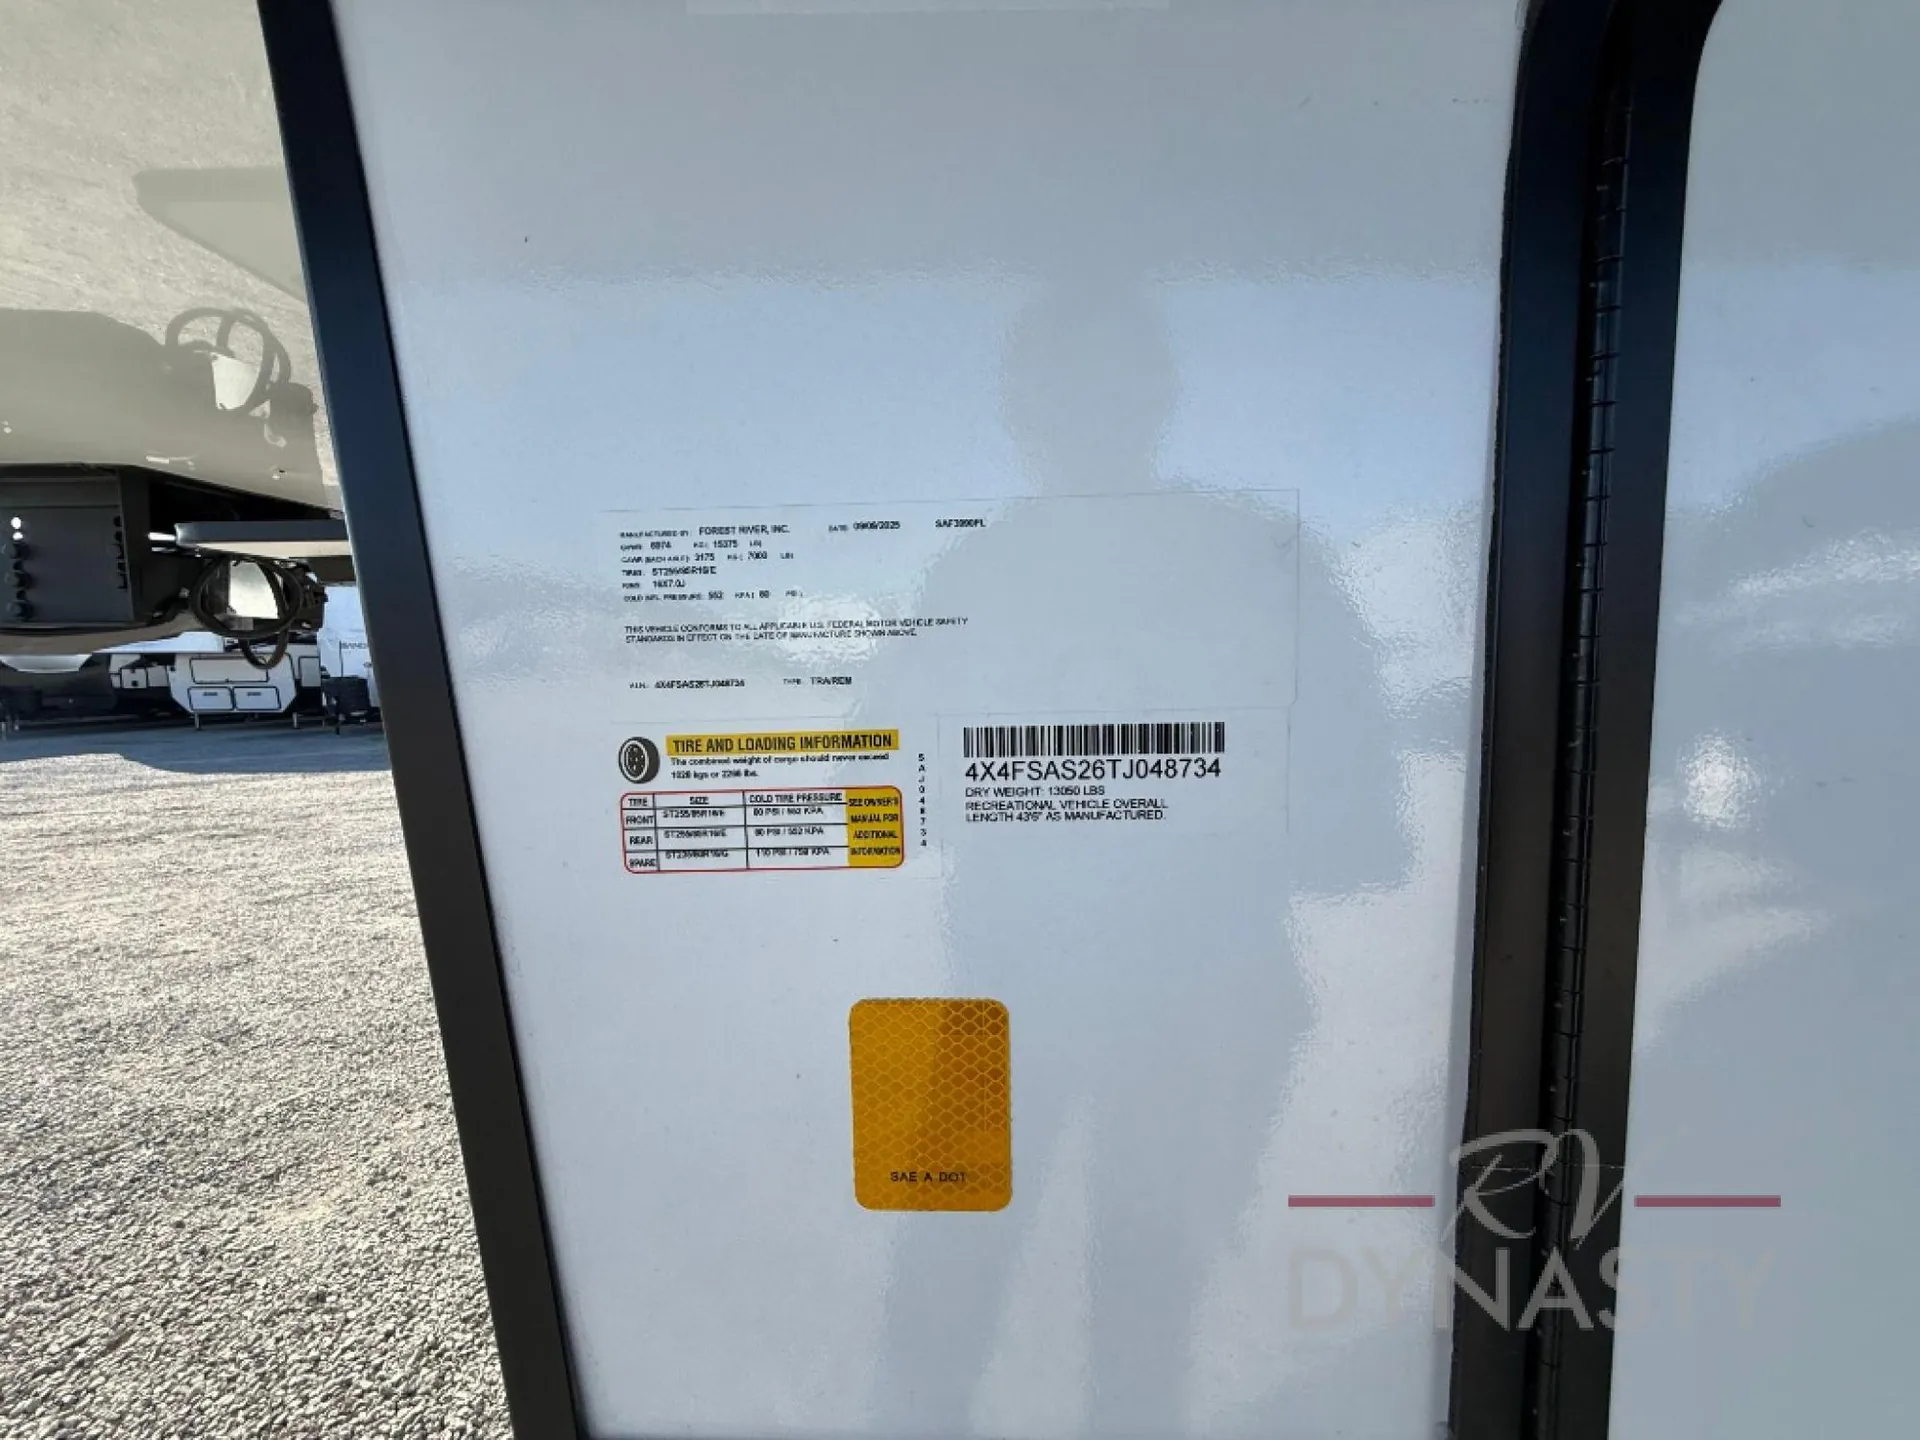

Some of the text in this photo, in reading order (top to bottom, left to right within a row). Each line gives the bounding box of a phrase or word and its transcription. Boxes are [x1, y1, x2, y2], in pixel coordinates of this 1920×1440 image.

[699, 526, 736, 536] FOREST
[827, 620, 864, 629] FEDERAL
[687, 633, 718, 642] EFFECT
[672, 733, 892, 753] TIRE AND LOADING INFORMATION
[671, 757, 687, 766] The
[688, 756, 731, 765] combined
[733, 755, 761, 766] weight
[763, 755, 773, 764] of
[800, 753, 829, 763] should
[832, 754, 856, 762] never
[965, 757, 1221, 782] 4X4FSAS26TJ048734
[965, 786, 992, 798] DRY
[1083, 784, 1105, 796] LBS
[627, 797, 648, 807] TIRE
[689, 795, 710, 805] SIZE
[750, 792, 843, 803] COLD TIRE PRESSURE
[848, 798, 862, 807] SEE
[965, 798, 1168, 811] RECREATIONAL VEHICLE OVERALL
[625, 815, 654, 825] FRONT
[850, 813, 881, 823] MANUAL
[965, 811, 1014, 823] LENGTH
[1045, 810, 1061, 822] AS
[629, 835, 653, 845] REAR
[629, 857, 656, 868] SPARE
[890, 1171, 966, 1182] SAE A DOT
